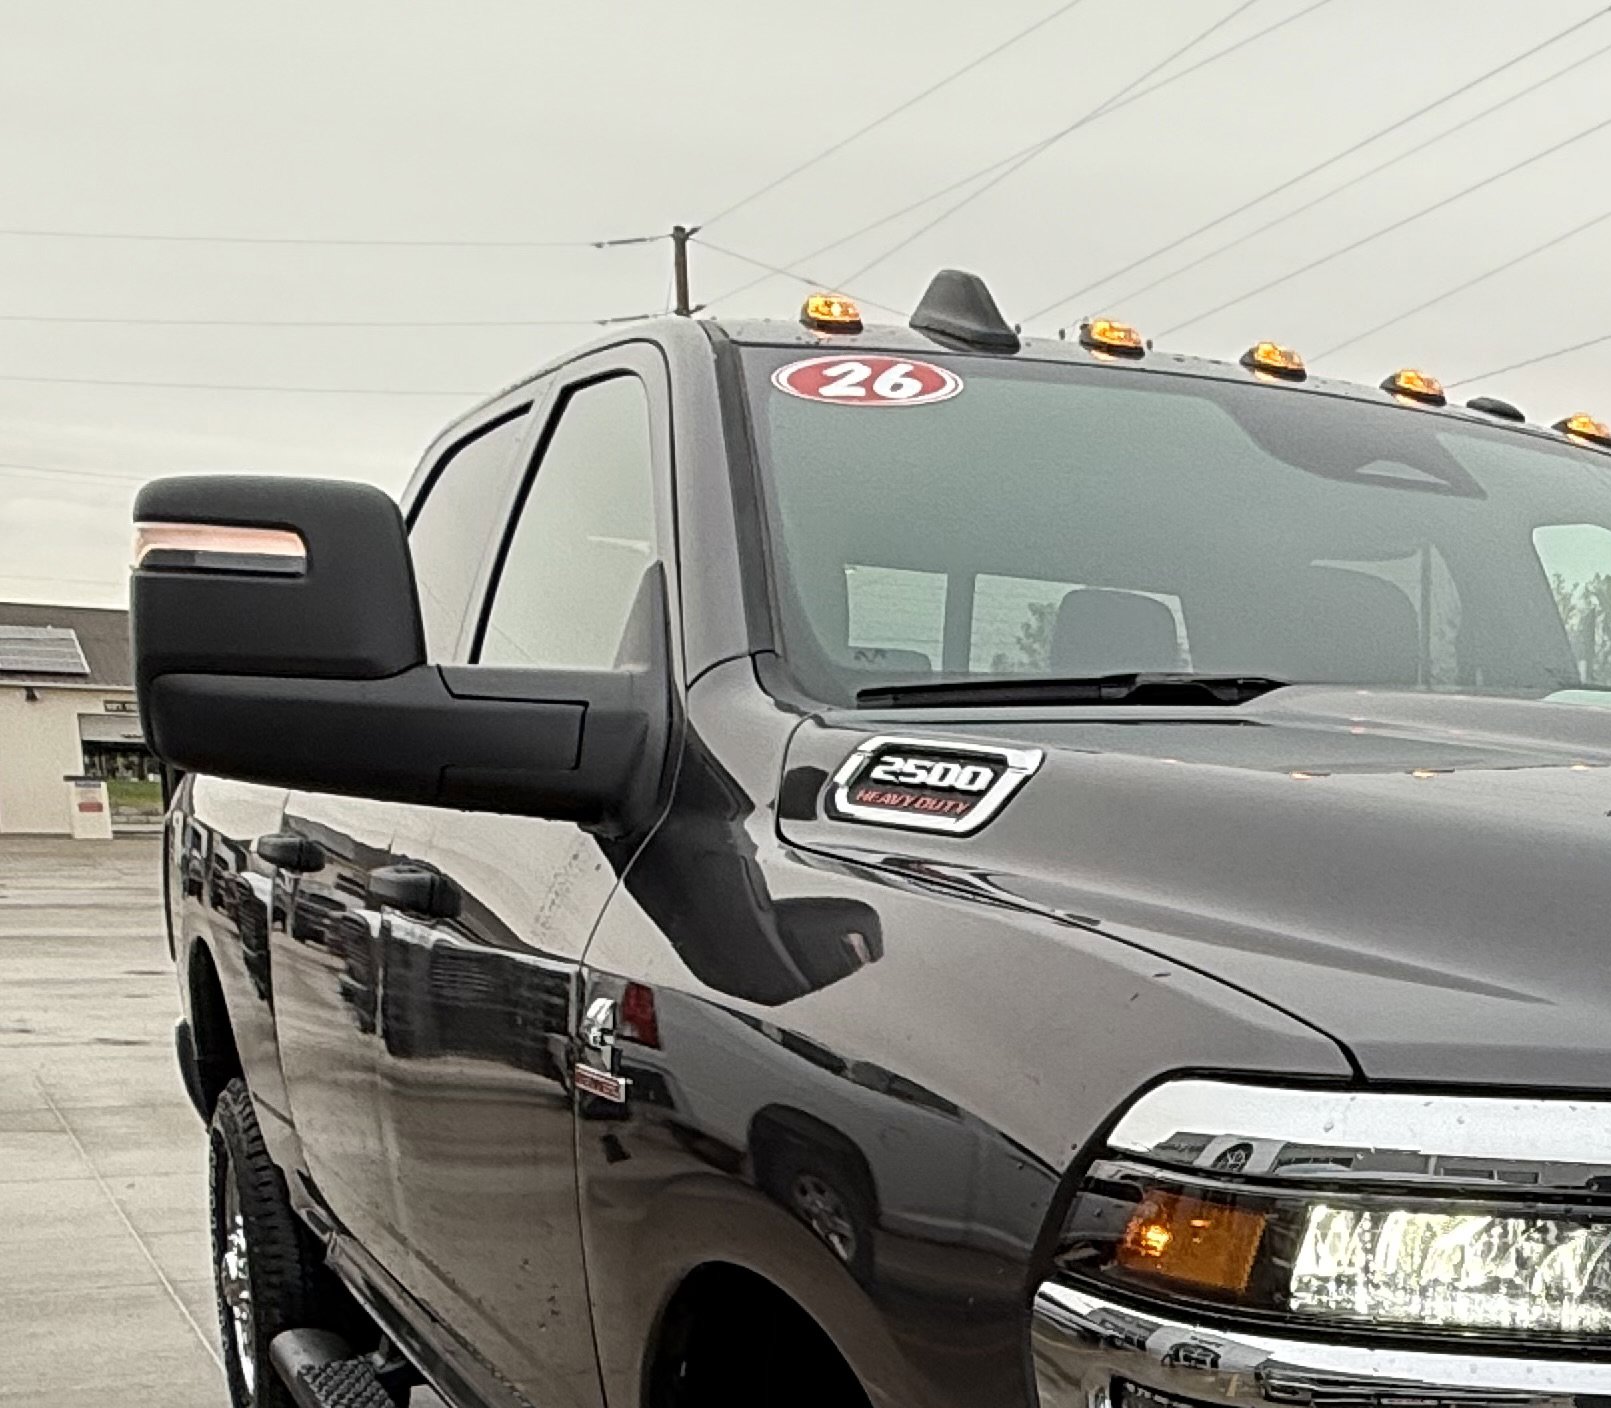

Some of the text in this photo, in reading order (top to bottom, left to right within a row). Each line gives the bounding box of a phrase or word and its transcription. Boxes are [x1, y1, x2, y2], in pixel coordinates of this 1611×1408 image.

[818, 361, 924, 399] 26
[869, 755, 996, 792] 2500
[856, 788, 971, 814] HEAVY DUTY
